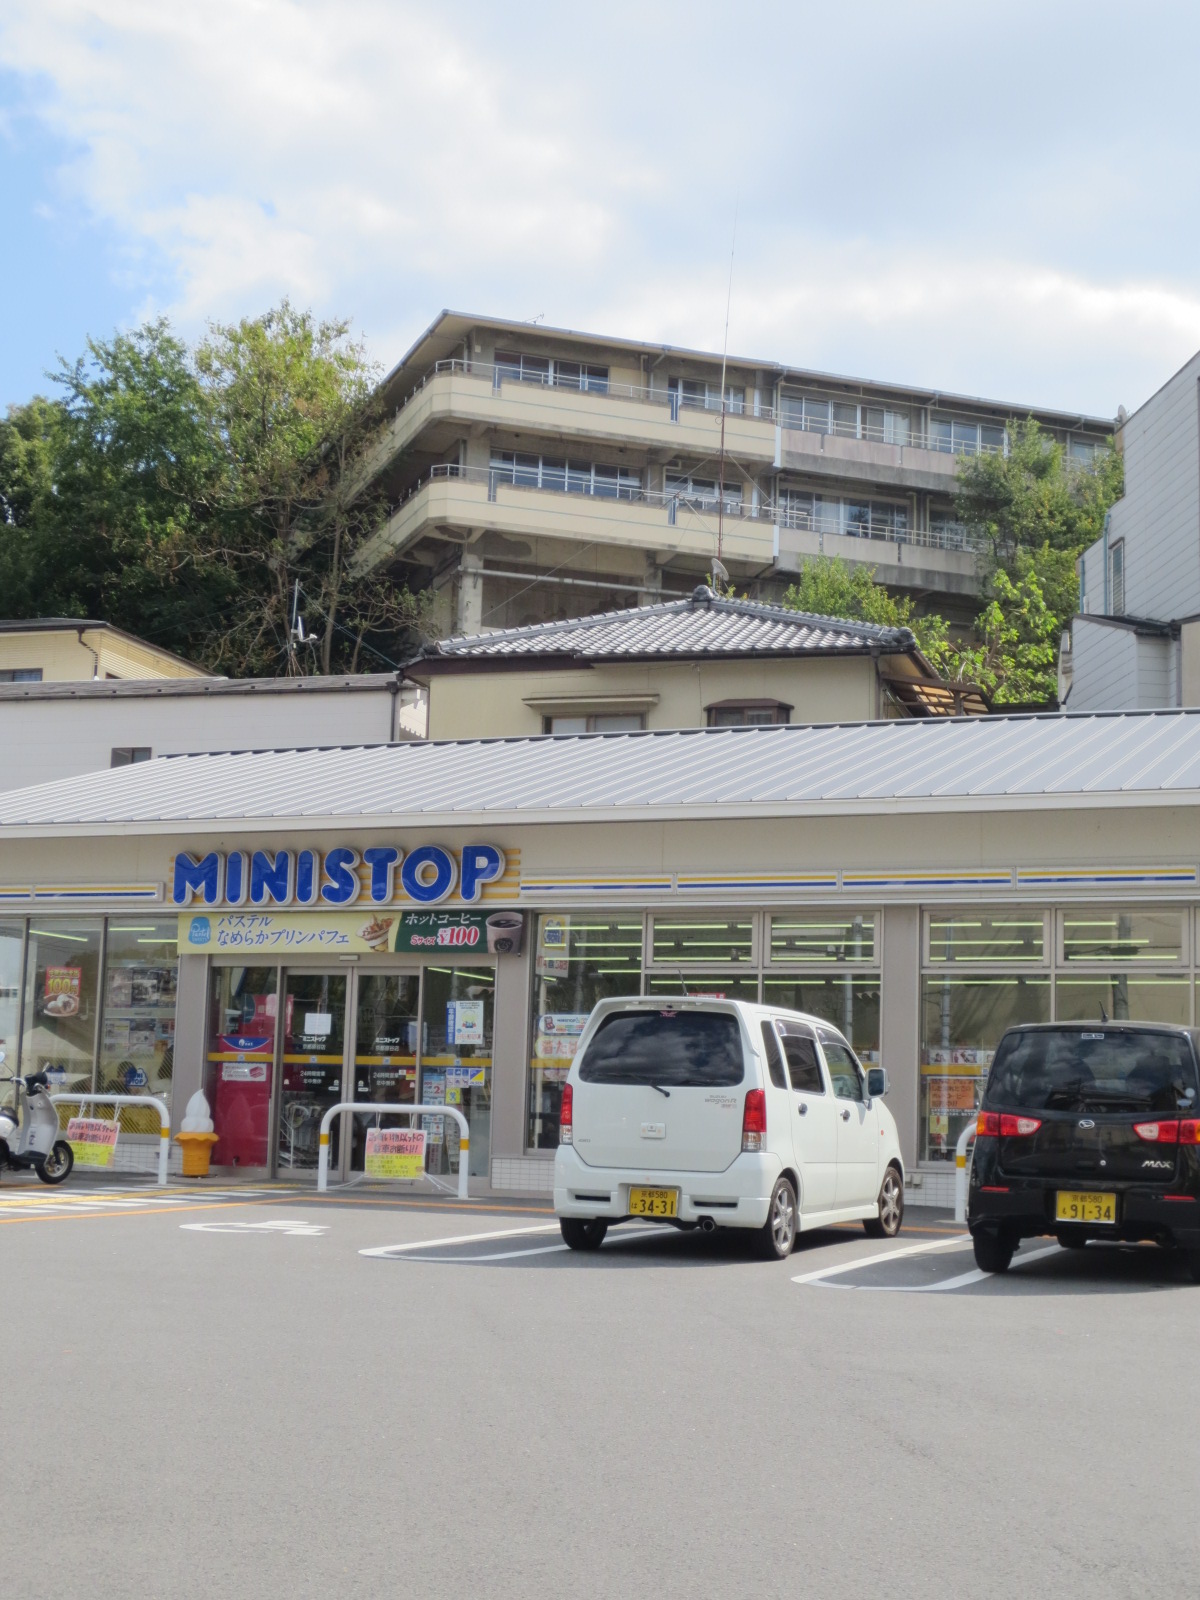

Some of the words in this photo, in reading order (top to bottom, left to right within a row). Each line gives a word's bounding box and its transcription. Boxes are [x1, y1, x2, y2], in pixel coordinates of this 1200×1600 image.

[173, 844, 504, 907] MINISTOP
[217, 914, 274, 928] パステル
[405, 912, 482, 925] ホットコーヒー
[217, 929, 350, 946] なめらかプリンパフェ
[410, 934, 436, 945] Sサイズ
[1141, 1160, 1171, 1169] MAX
[639, 1199, 674, 1214] 34-31
[1070, 1204, 1111, 1220] 91-34
